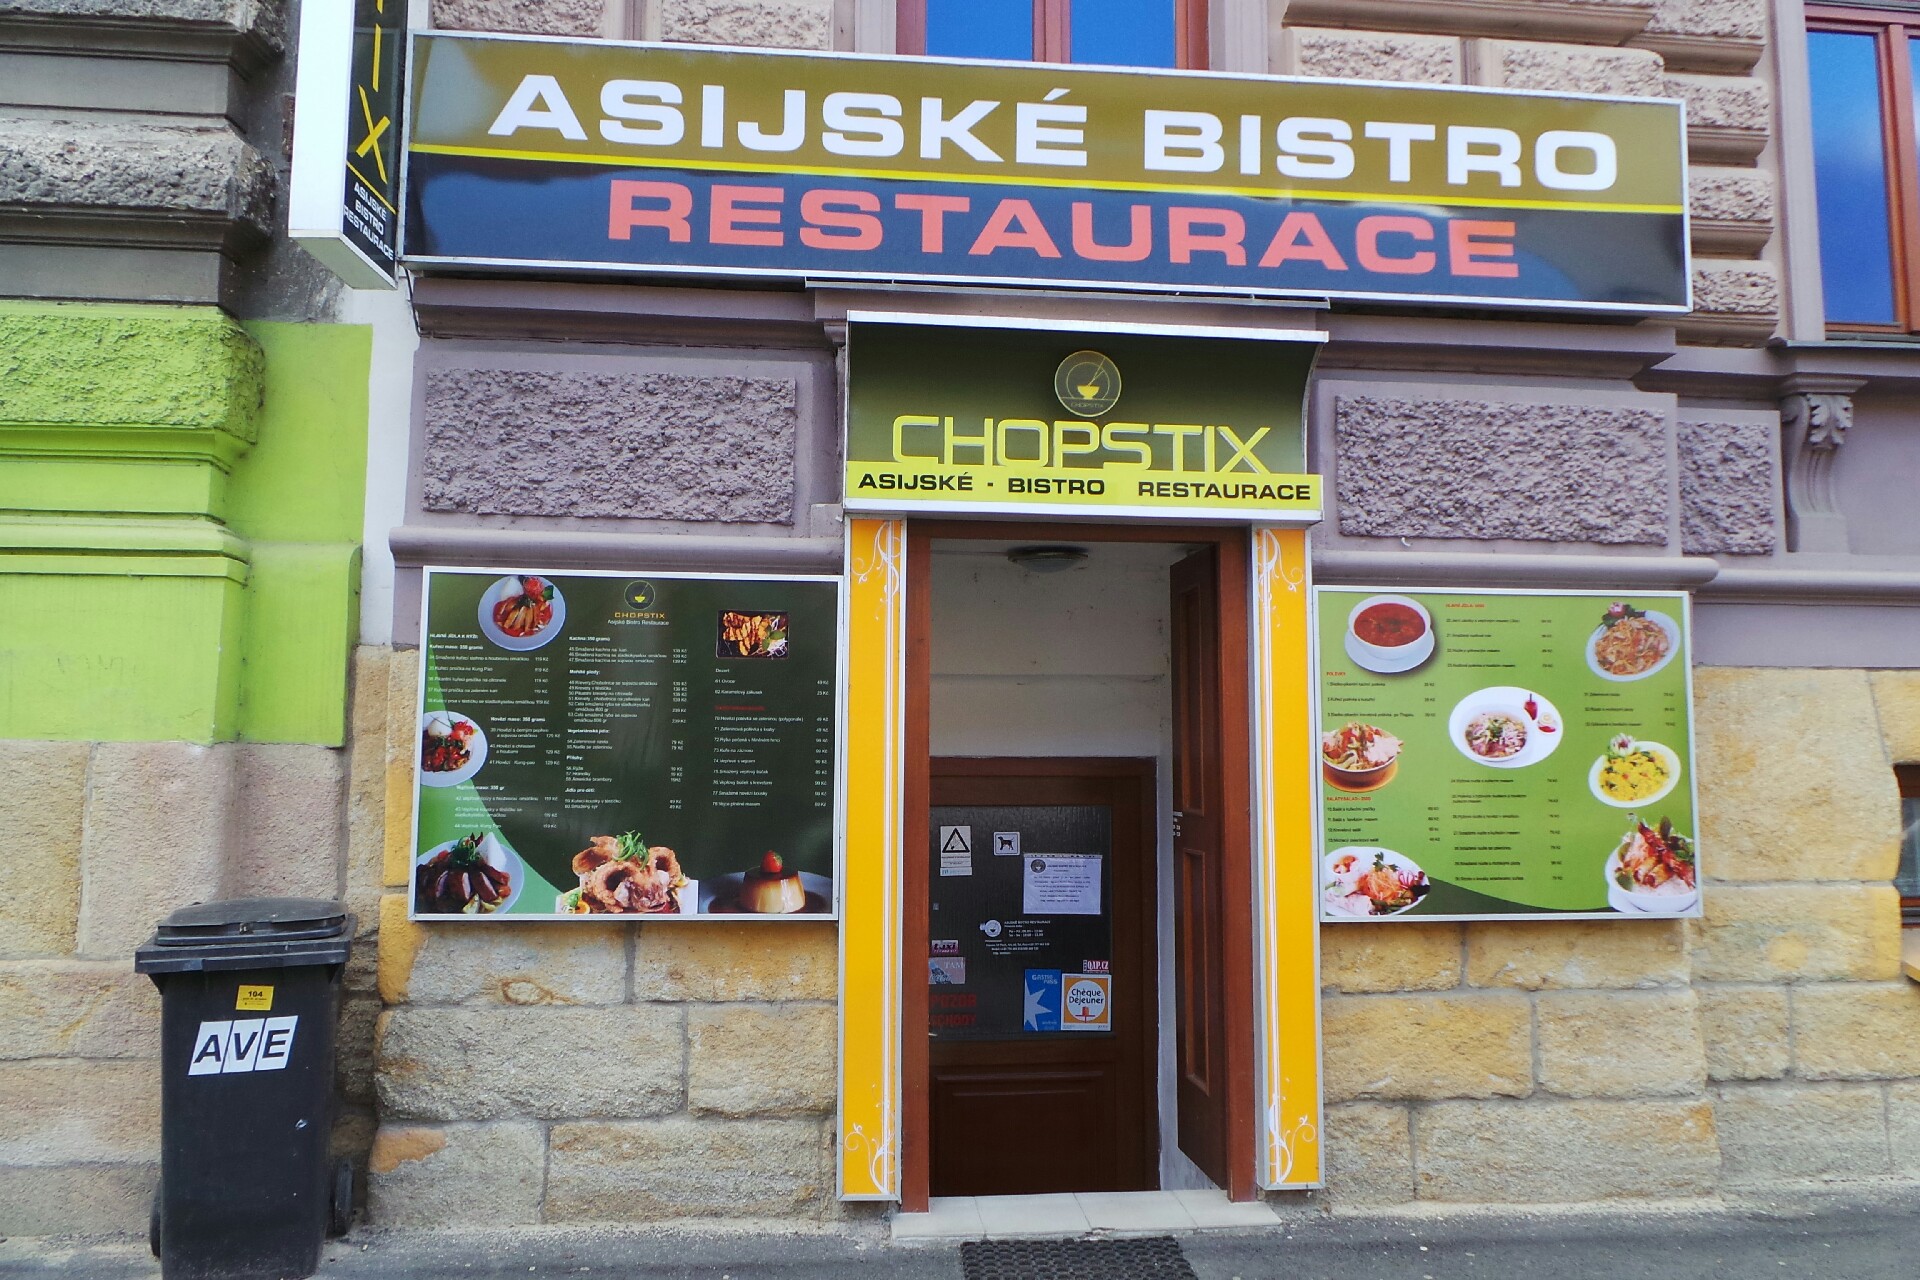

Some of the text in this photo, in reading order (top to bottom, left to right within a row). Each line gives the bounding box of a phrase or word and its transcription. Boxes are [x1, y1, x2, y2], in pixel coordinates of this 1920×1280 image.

[487, 74, 1617, 191] ASIJSKÉ BISTRO
[354, 182, 388, 222] ASIJSKÉ
[355, 199, 384, 236] BISTRO
[343, 204, 394, 261] RESTAURACE
[608, 180, 1520, 278] RESTAURACE
[892, 415, 1271, 474] CHOPSTIX
[858, 471, 973, 491] ASIJSKÉ
[1008, 477, 1105, 495] BISTRO
[1138, 480, 1311, 501] RESTAURACE
[1087, 960, 1109, 970] QAP.CZ
[1072, 988, 1101, 998] Chèque
[193, 1028, 290, 1064] AVE
